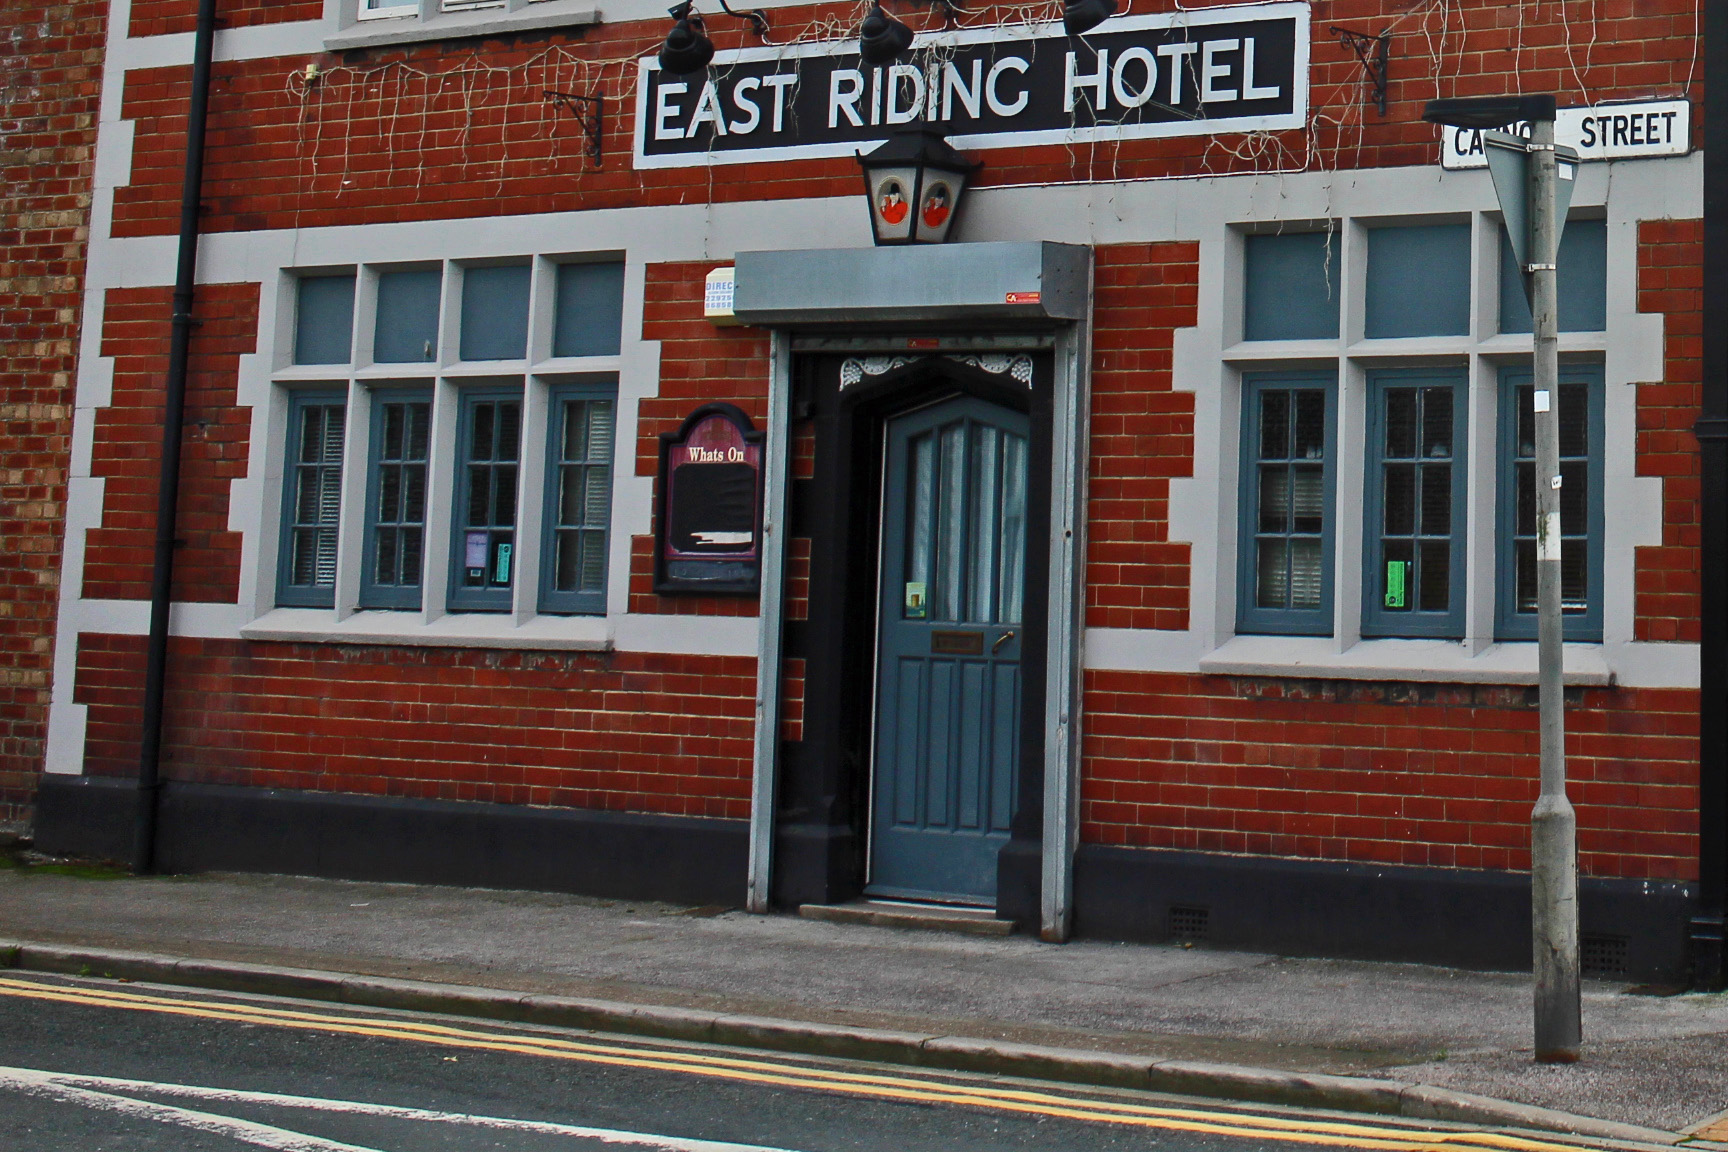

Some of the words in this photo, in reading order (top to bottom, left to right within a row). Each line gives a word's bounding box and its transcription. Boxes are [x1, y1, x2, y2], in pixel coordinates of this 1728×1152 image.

[655, 74, 798, 140] EAST
[828, 57, 1029, 128] RIDING
[1064, 38, 1280, 113] HOTEL
[1580, 112, 1677, 148] STREET
[689, 447, 724, 462] Whats
[728, 447, 744, 462] On
